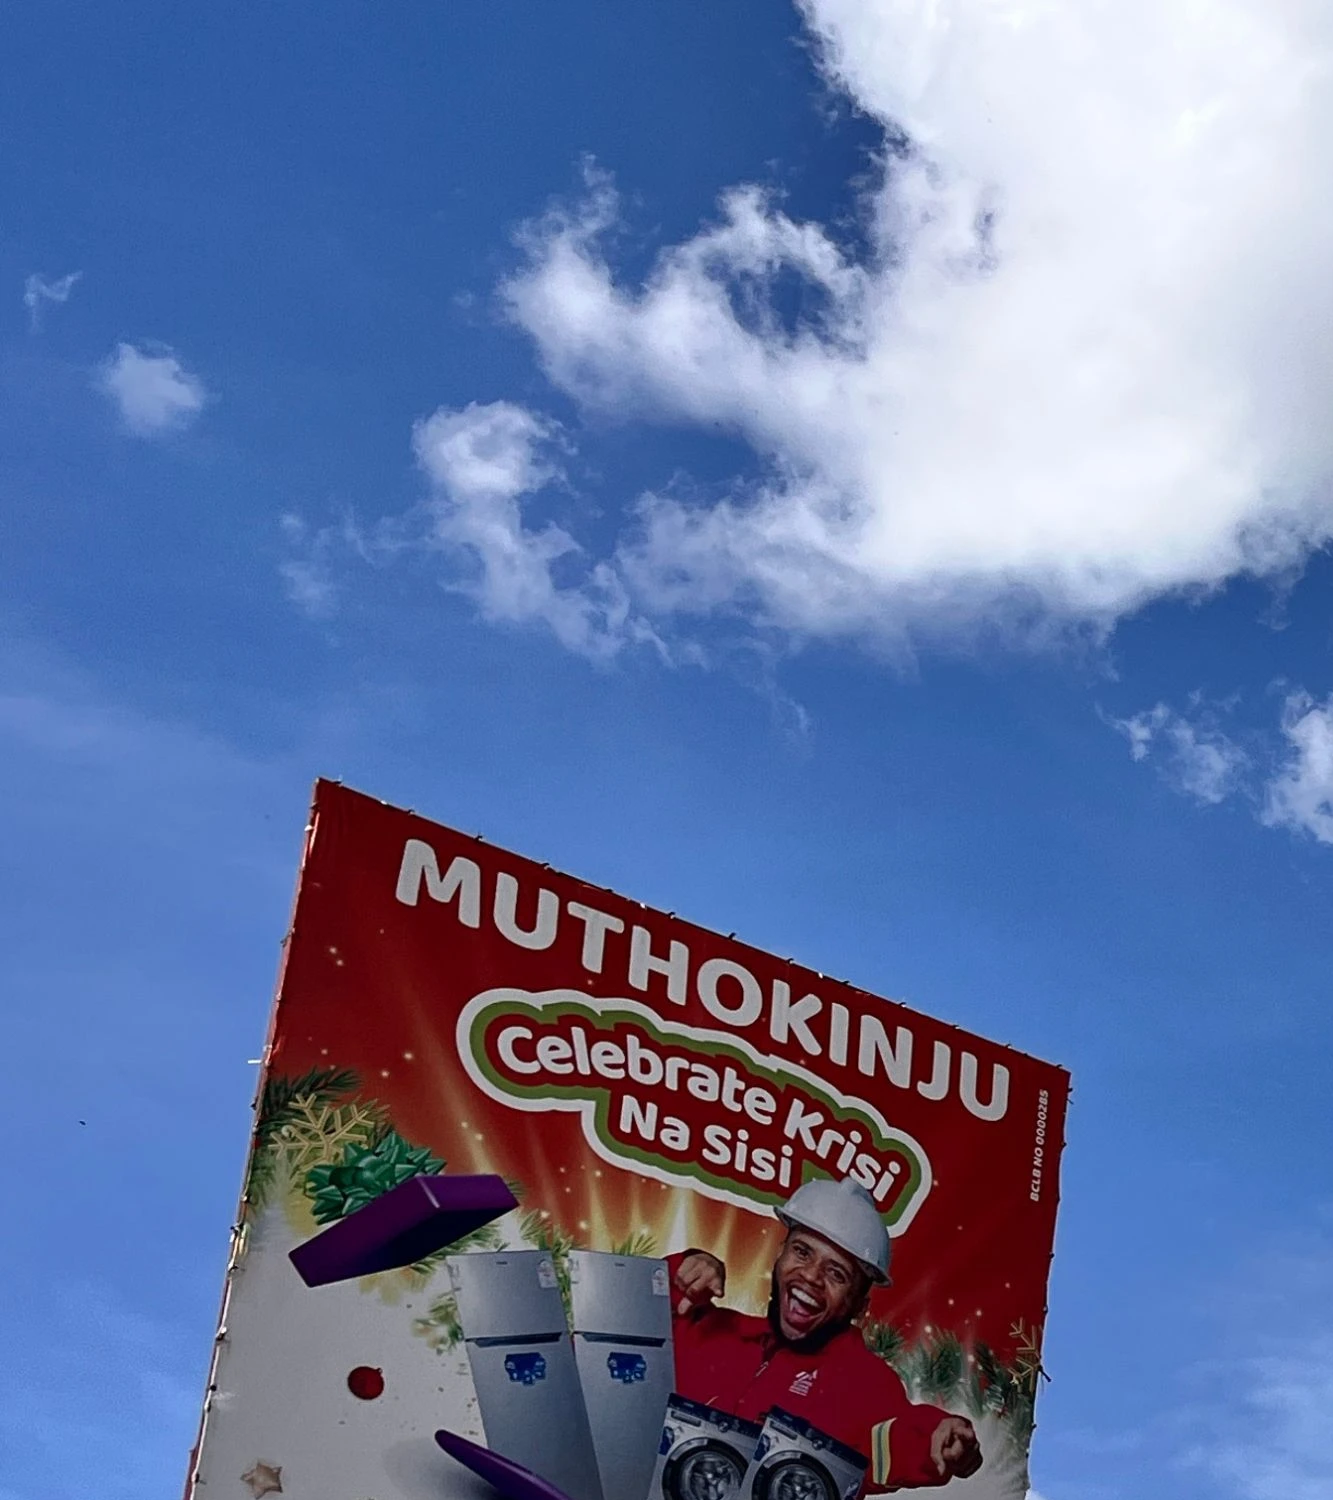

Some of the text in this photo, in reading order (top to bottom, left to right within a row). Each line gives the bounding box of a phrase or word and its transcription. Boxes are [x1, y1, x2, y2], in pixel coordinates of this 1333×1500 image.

[395, 838, 1011, 1122] MUTHOKINJU
[497, 1026, 902, 1203] Celebrate Krisi
[619, 1094, 794, 1188] Na Sisi
[1033, 1147, 1044, 1167] NO
[1029, 1168, 1042, 1202] BCLB
